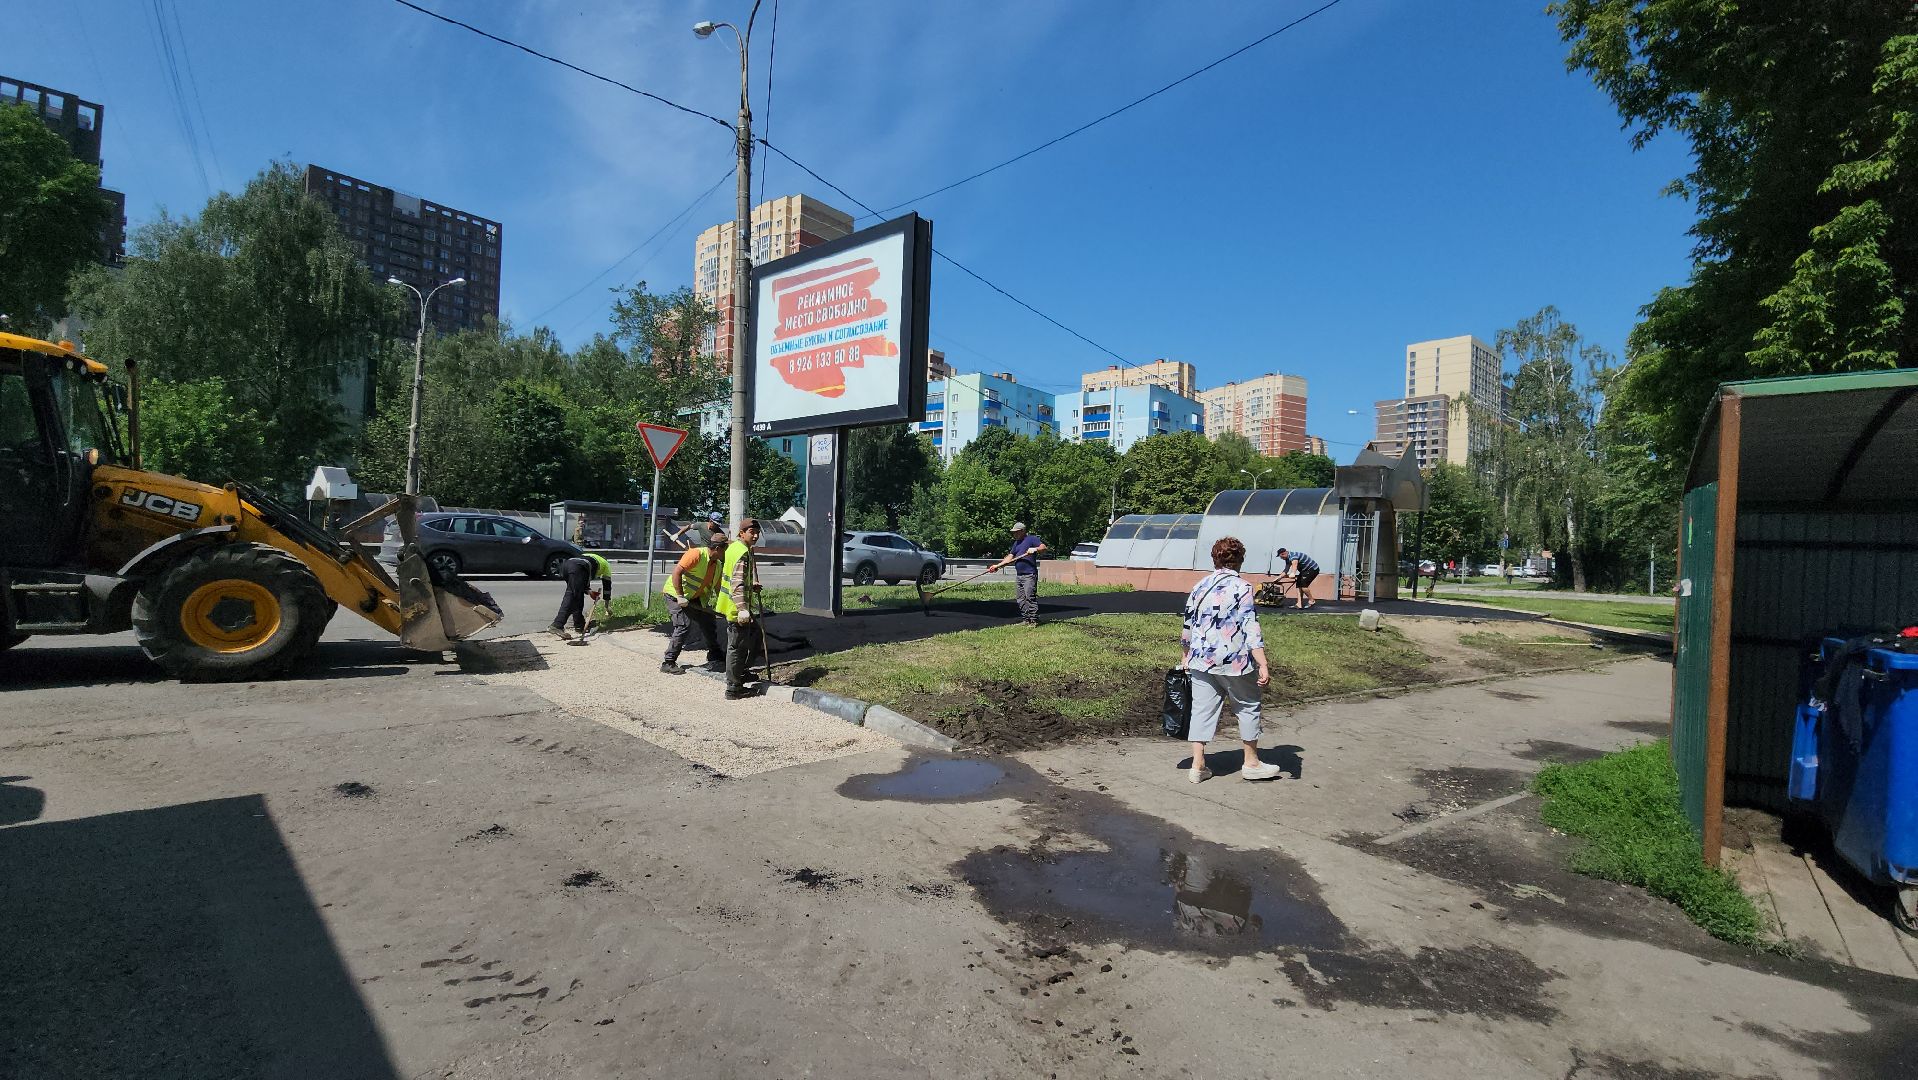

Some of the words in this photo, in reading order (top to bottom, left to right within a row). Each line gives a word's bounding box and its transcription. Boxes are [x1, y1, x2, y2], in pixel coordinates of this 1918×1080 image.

[797, 282, 854, 310] РЕКЛАМНОЕ
[785, 311, 814, 331] МЕСТО
[816, 297, 868, 323] СВОБОДНО
[804, 333, 827, 348] БУКВЫ
[828, 331, 833, 341] И
[834, 318, 889, 341] СОГЛАСОВАНИЕ
[789, 360, 795, 374] 8
[796, 355, 813, 372] 926
[815, 351, 832, 368] 133
[121, 488, 200, 522] JCB
